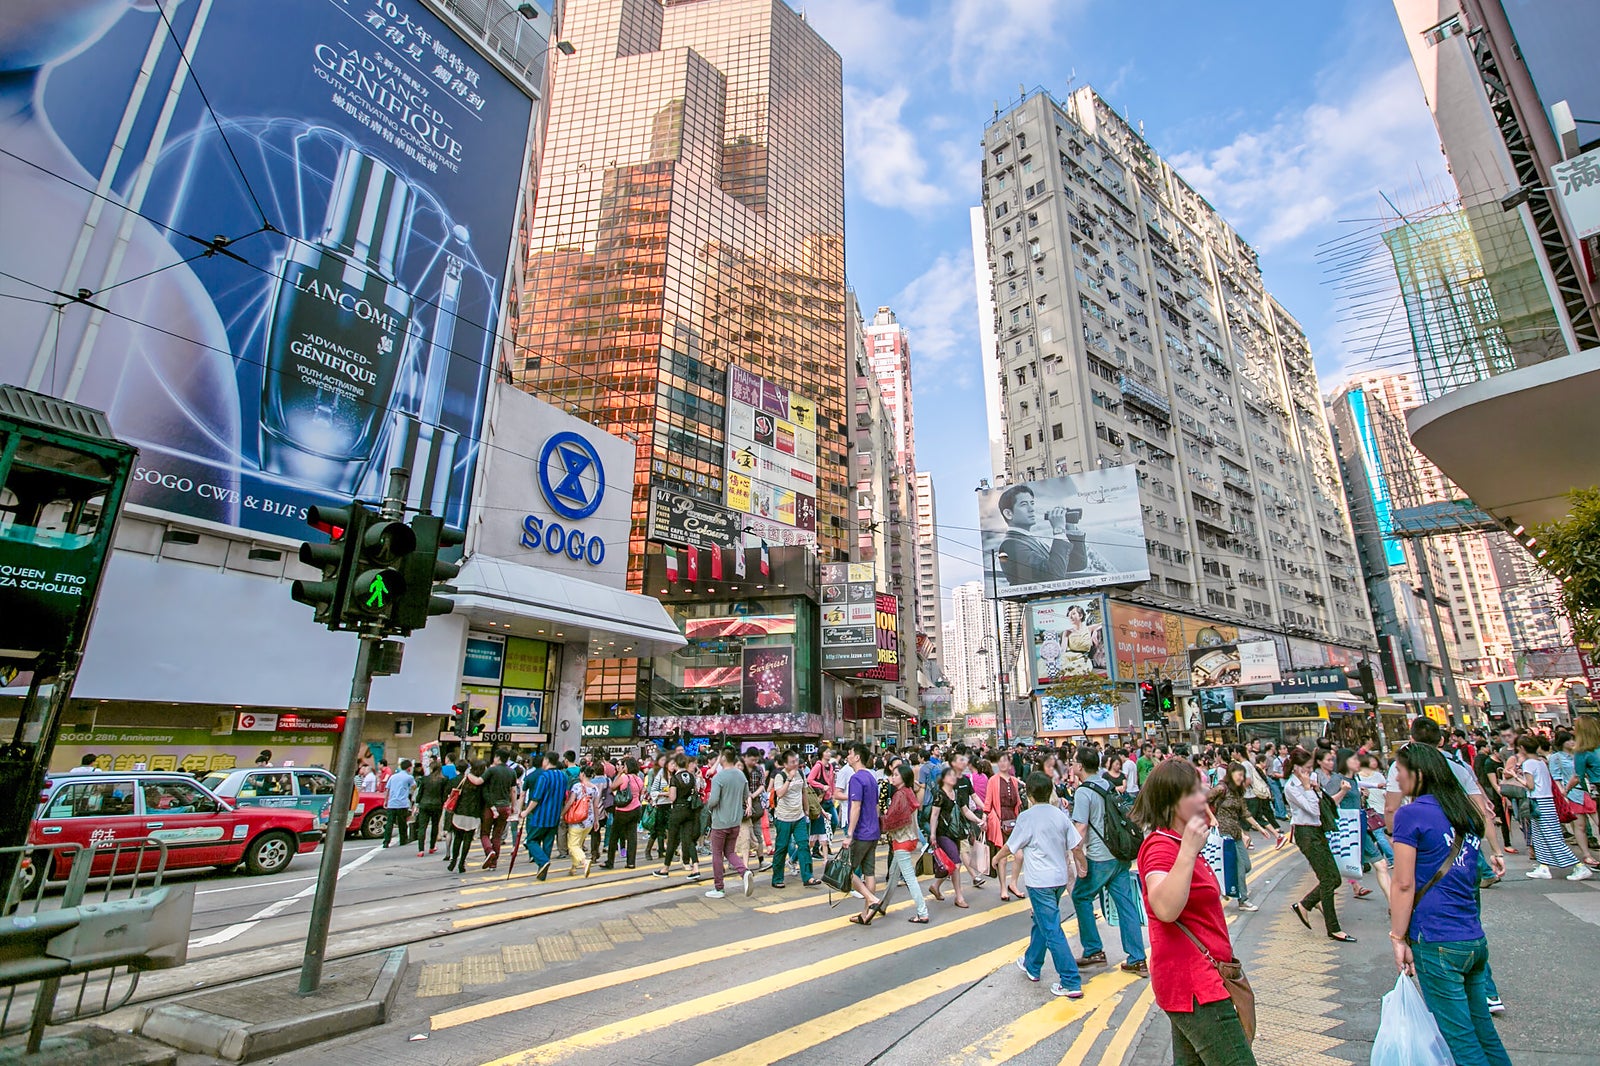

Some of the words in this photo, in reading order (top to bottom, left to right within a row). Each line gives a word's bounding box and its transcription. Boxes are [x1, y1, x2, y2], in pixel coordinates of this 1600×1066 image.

[312, 64, 348, 93] YOUTH
[347, 91, 399, 132] ACTIVATING
[399, 127, 459, 174] CONCENTRATE
[294, 271, 399, 336] LANCÔME
[290, 340, 377, 386] GÉNIFIQUE
[296, 364, 323, 381] YOUTH
[321, 373, 365, 397] ACTIVATING
[300, 375, 358, 402] CONCENTRATE
[133, 467, 194, 493] SOGO
[197, 483, 240, 504] CWB
[243, 495, 259, 511] &
[262, 501, 297, 520] B1/F
[520, 514, 605, 566] SOGO
[0, 565, 46, 579] QUEEN
[54, 572, 86, 585] ETRO
[0, 576, 17, 587] ZA
[20, 580, 83, 596] SCHOULER
[876, 611, 896, 632] ION
[876, 629, 897, 651] NG
[877, 648, 897, 664] ORIES
[60, 733, 93, 742] SOGO
[95, 734, 117, 742] 28th
[119, 734, 174, 743] Anniversary
[483, 732, 512, 742] SOGO
[91, 828, 116, 839] 的士
